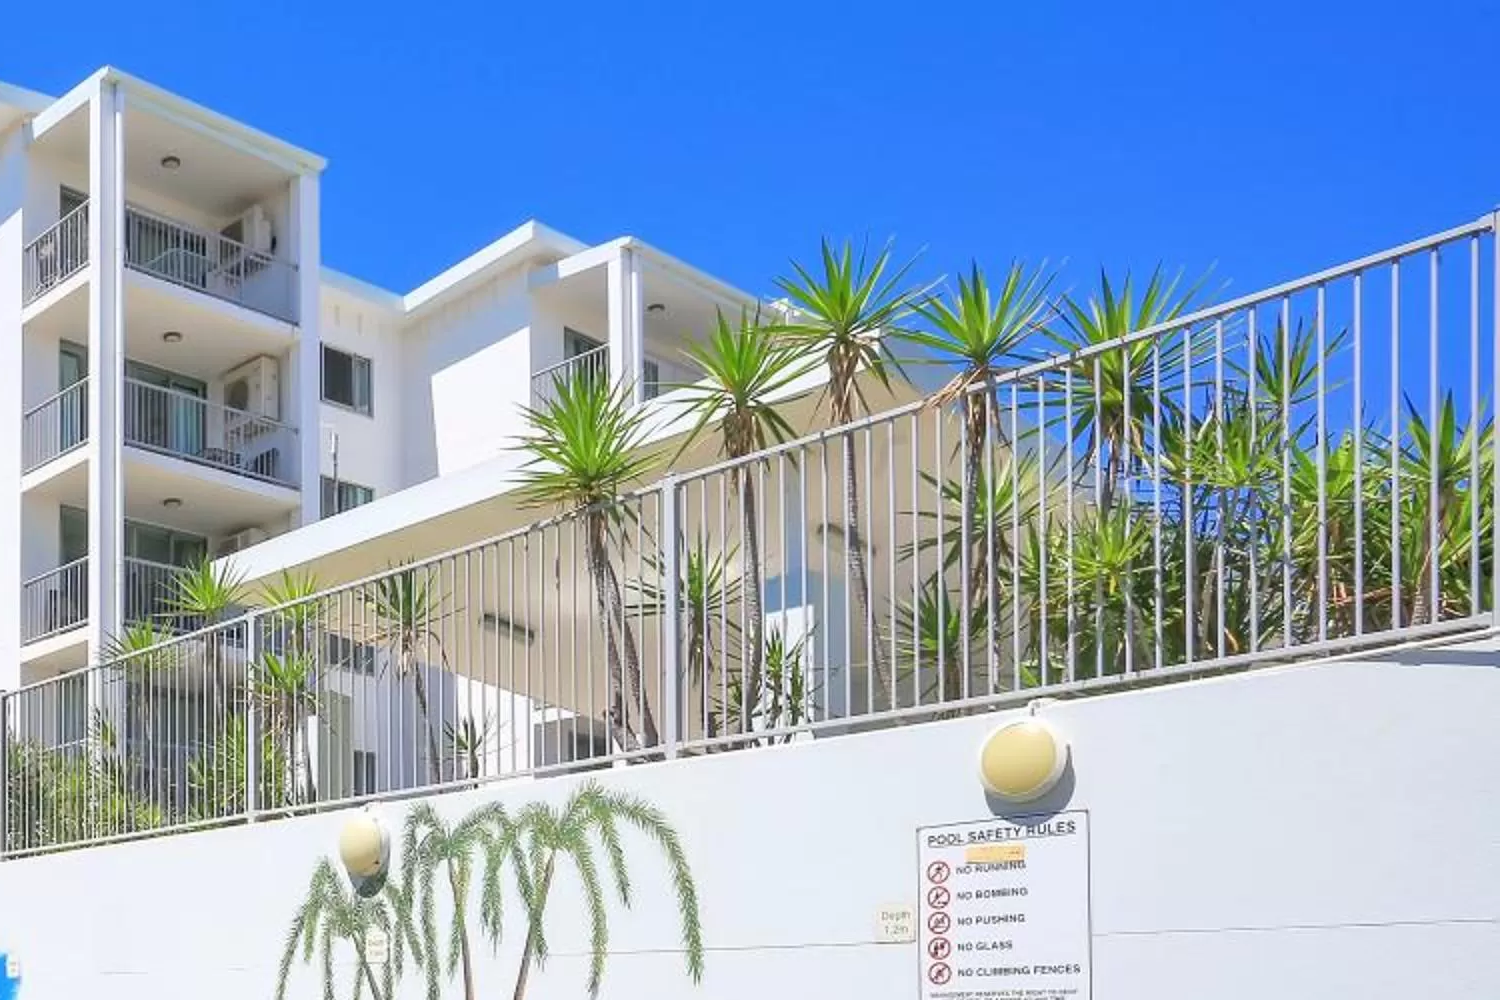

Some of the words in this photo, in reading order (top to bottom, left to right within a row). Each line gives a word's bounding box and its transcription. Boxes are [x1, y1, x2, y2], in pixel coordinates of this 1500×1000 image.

[927, 834, 964, 846] POOL
[968, 826, 1021, 843] SAFETY
[1026, 821, 1077, 836] RULES
[956, 865, 972, 875] NO
[975, 860, 1027, 873] RUNNING
[957, 891, 973, 900] NO
[975, 887, 1029, 900] BOMBING
[957, 916, 973, 926] NO
[975, 914, 1026, 925] PUSHING
[957, 943, 973, 951] NO
[976, 940, 1013, 951] GLASS
[957, 968, 973, 977] NO
[976, 966, 1031, 977] CLIMBING
[1033, 964, 1081, 975] FENCES
